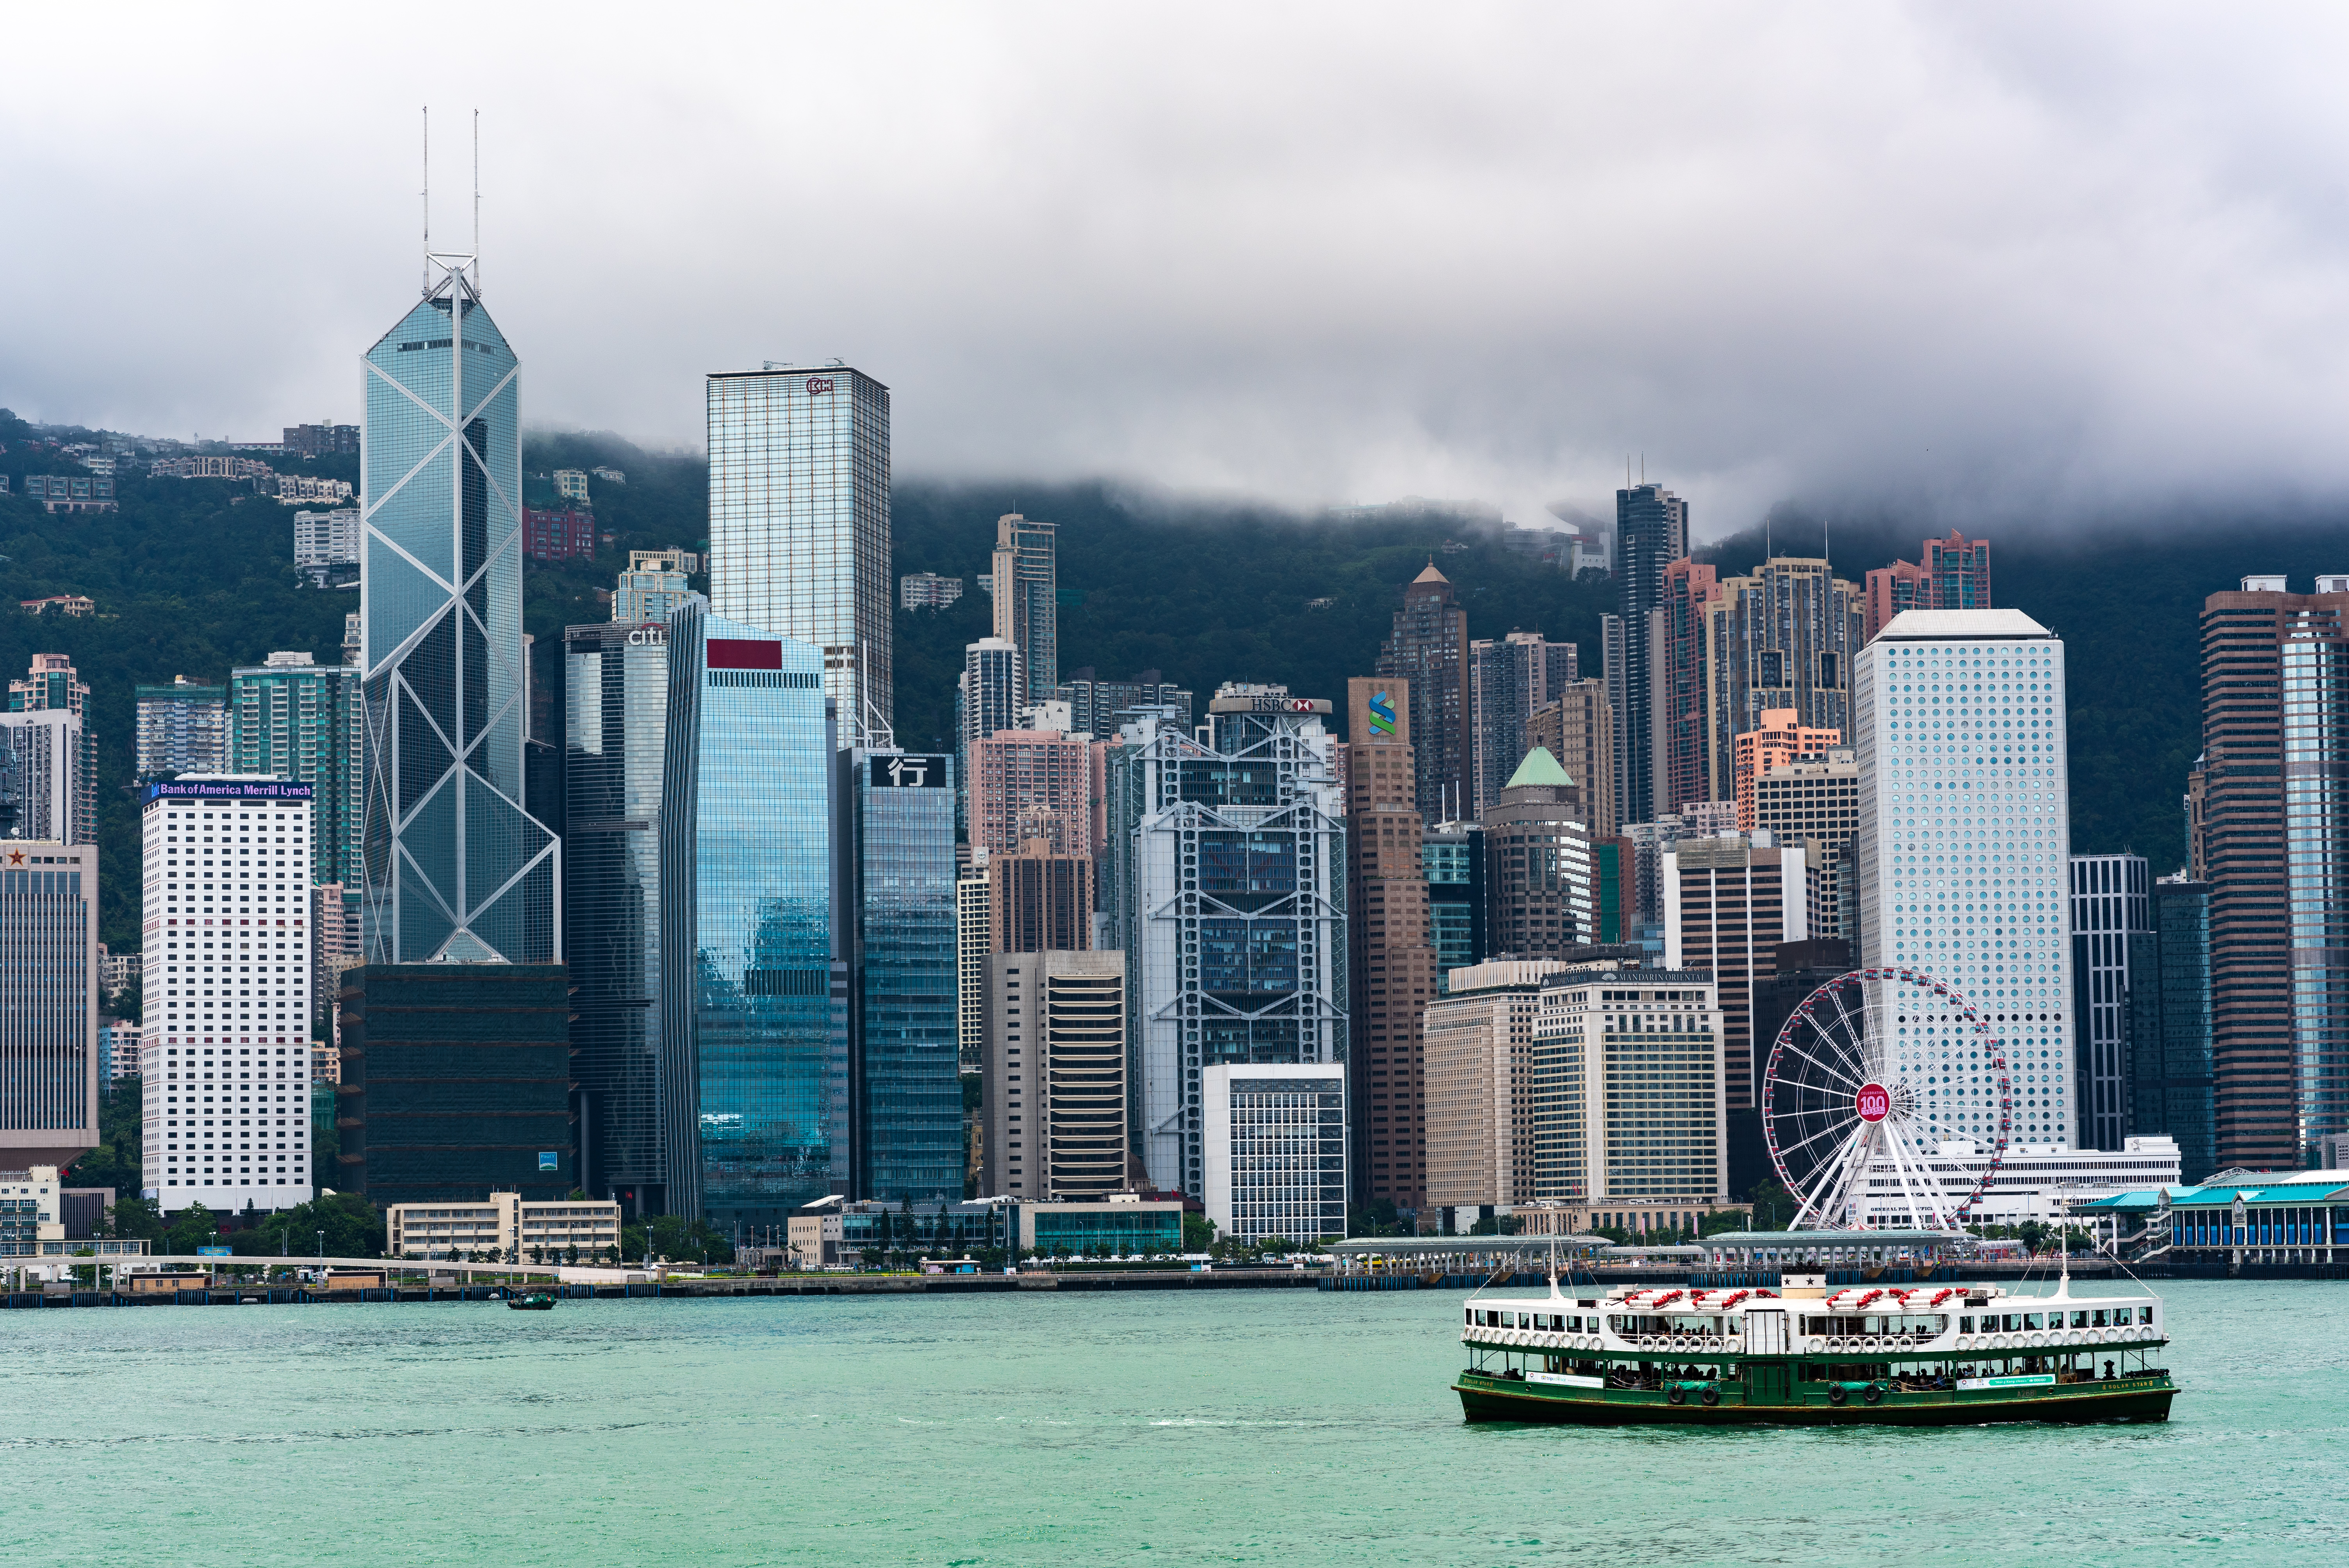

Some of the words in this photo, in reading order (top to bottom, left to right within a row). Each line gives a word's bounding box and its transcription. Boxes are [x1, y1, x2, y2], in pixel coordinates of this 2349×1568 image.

[629, 627, 662, 645] citi
[1250, 698, 1291, 711] HSBC
[888, 757, 927, 786] 行
[160, 784, 187, 794] Bank
[187, 784, 198, 794] of
[199, 784, 241, 795] America
[244, 785, 277, 795] Merrill
[281, 786, 310, 796] Lynch
[1550, 976, 1569, 986] MANDARIN
[1570, 975, 1588, 983] ORIENTAL
[1861, 1096, 1885, 1110] 100
